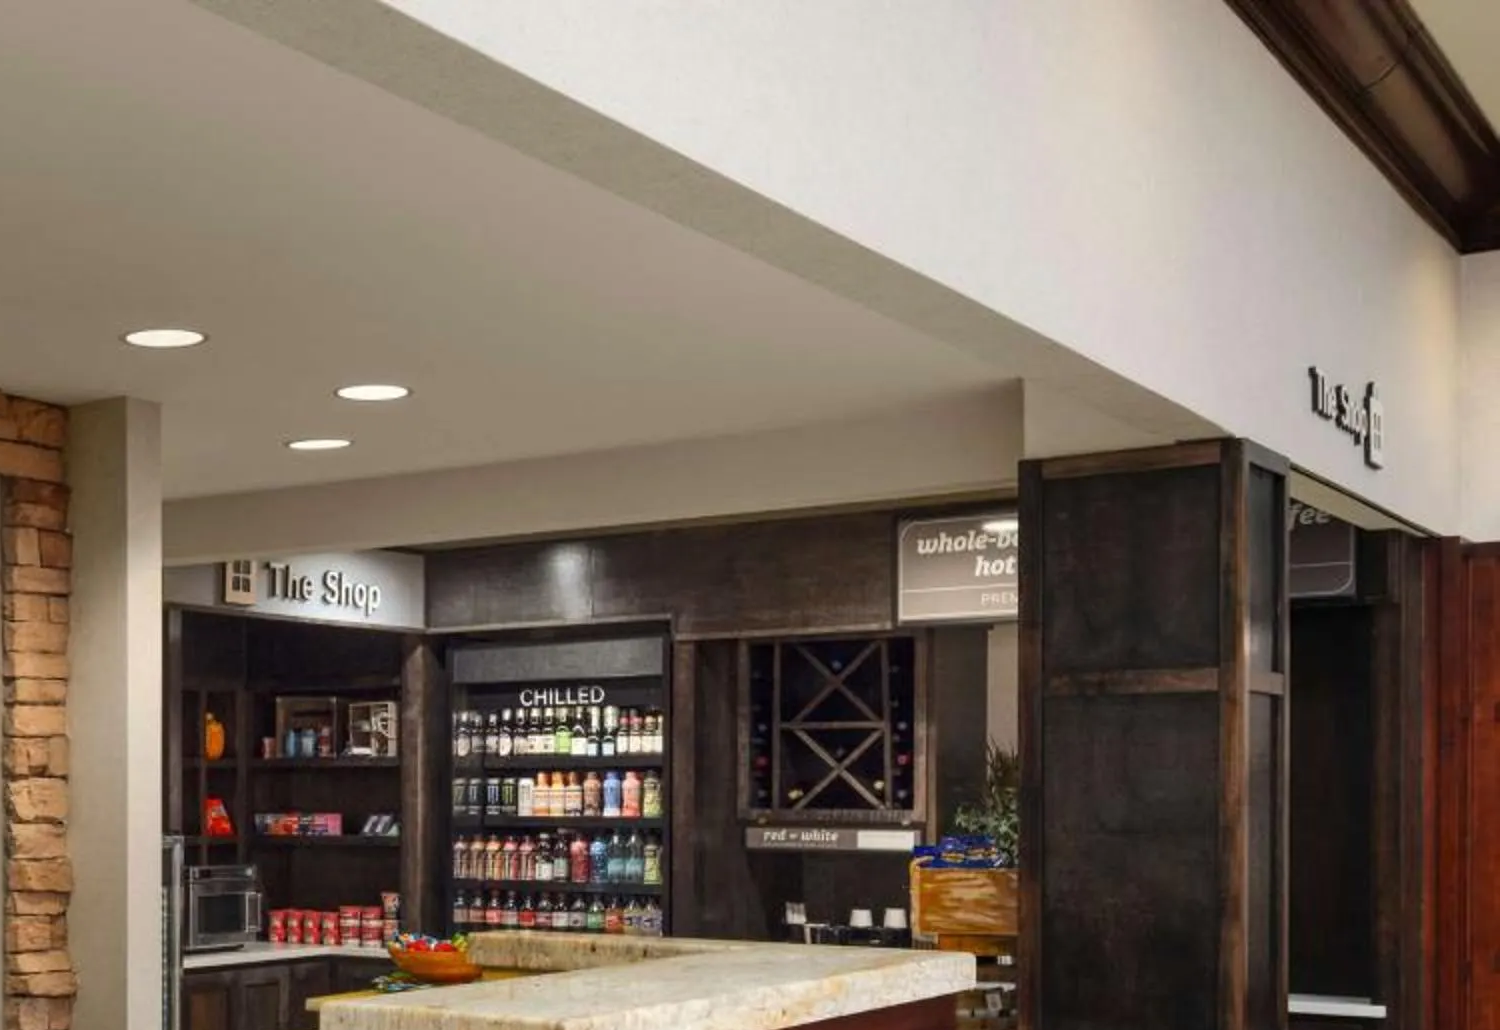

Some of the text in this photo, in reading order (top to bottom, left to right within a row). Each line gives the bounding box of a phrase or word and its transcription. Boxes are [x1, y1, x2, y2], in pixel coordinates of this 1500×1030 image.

[1308, 366, 1336, 421] The
[975, 555, 1016, 577] hot
[266, 561, 381, 617] The Shop
[520, 686, 605, 707] CHILLED
[763, 829, 787, 842] red
[801, 829, 838, 842] white
